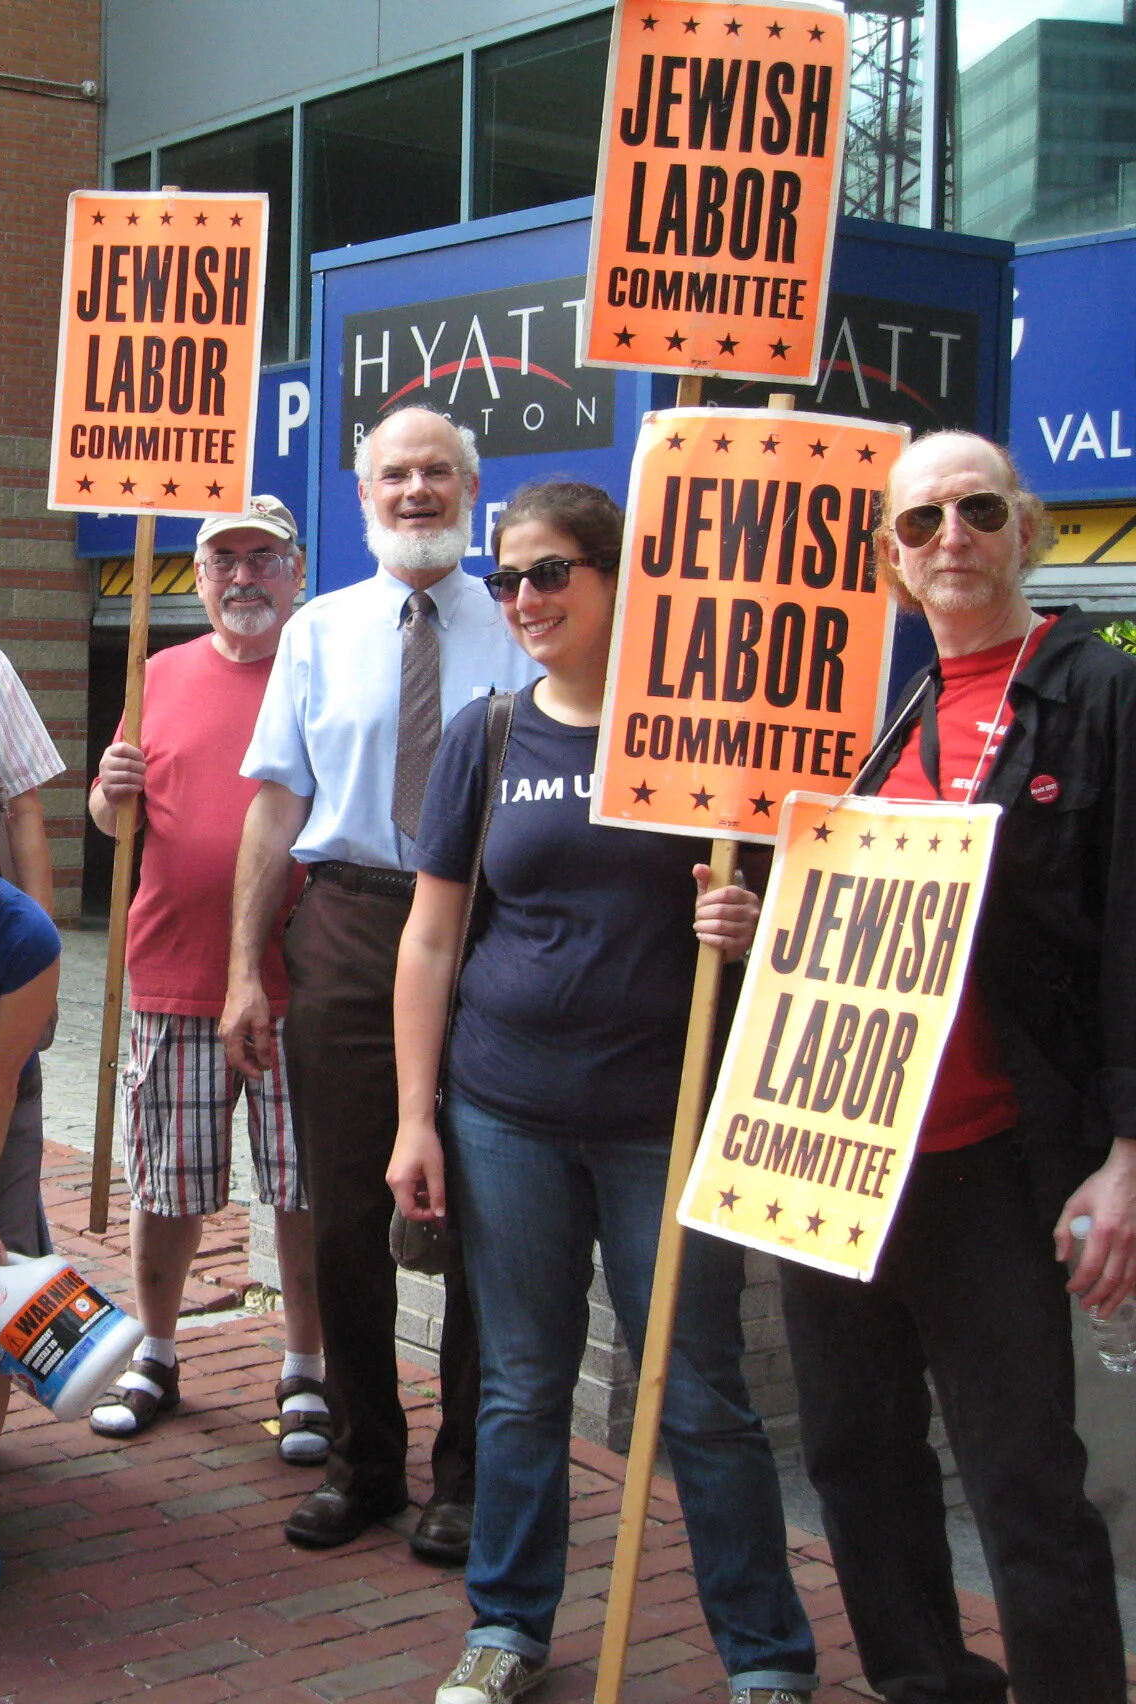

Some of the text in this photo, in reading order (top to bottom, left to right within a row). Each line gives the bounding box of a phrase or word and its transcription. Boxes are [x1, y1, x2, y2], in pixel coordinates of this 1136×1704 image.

[620, 55, 832, 158] JEWISH
[626, 162, 801, 264] LABOR
[77, 245, 250, 325] JEWISH
[607, 266, 807, 321] COMMITTEE
[85, 334, 228, 416] LABOR
[354, 299, 587, 405] HYATT
[816, 317, 961, 409] ATT
[70, 424, 236, 464] COMMITTEE
[353, 396, 596, 448] BTON
[1038, 410, 1131, 464] VAL
[641, 476, 879, 593] JEWISH
[646, 594, 849, 713] LABOR
[624, 712, 856, 779] COMMITTEE
[511, 777, 563, 802] AM
[771, 869, 970, 997] JEWISH
[753, 992, 918, 1128] LABOR
[722, 1113, 896, 1199] COMMITTEE
[15, 1271, 86, 1337] WARNING
